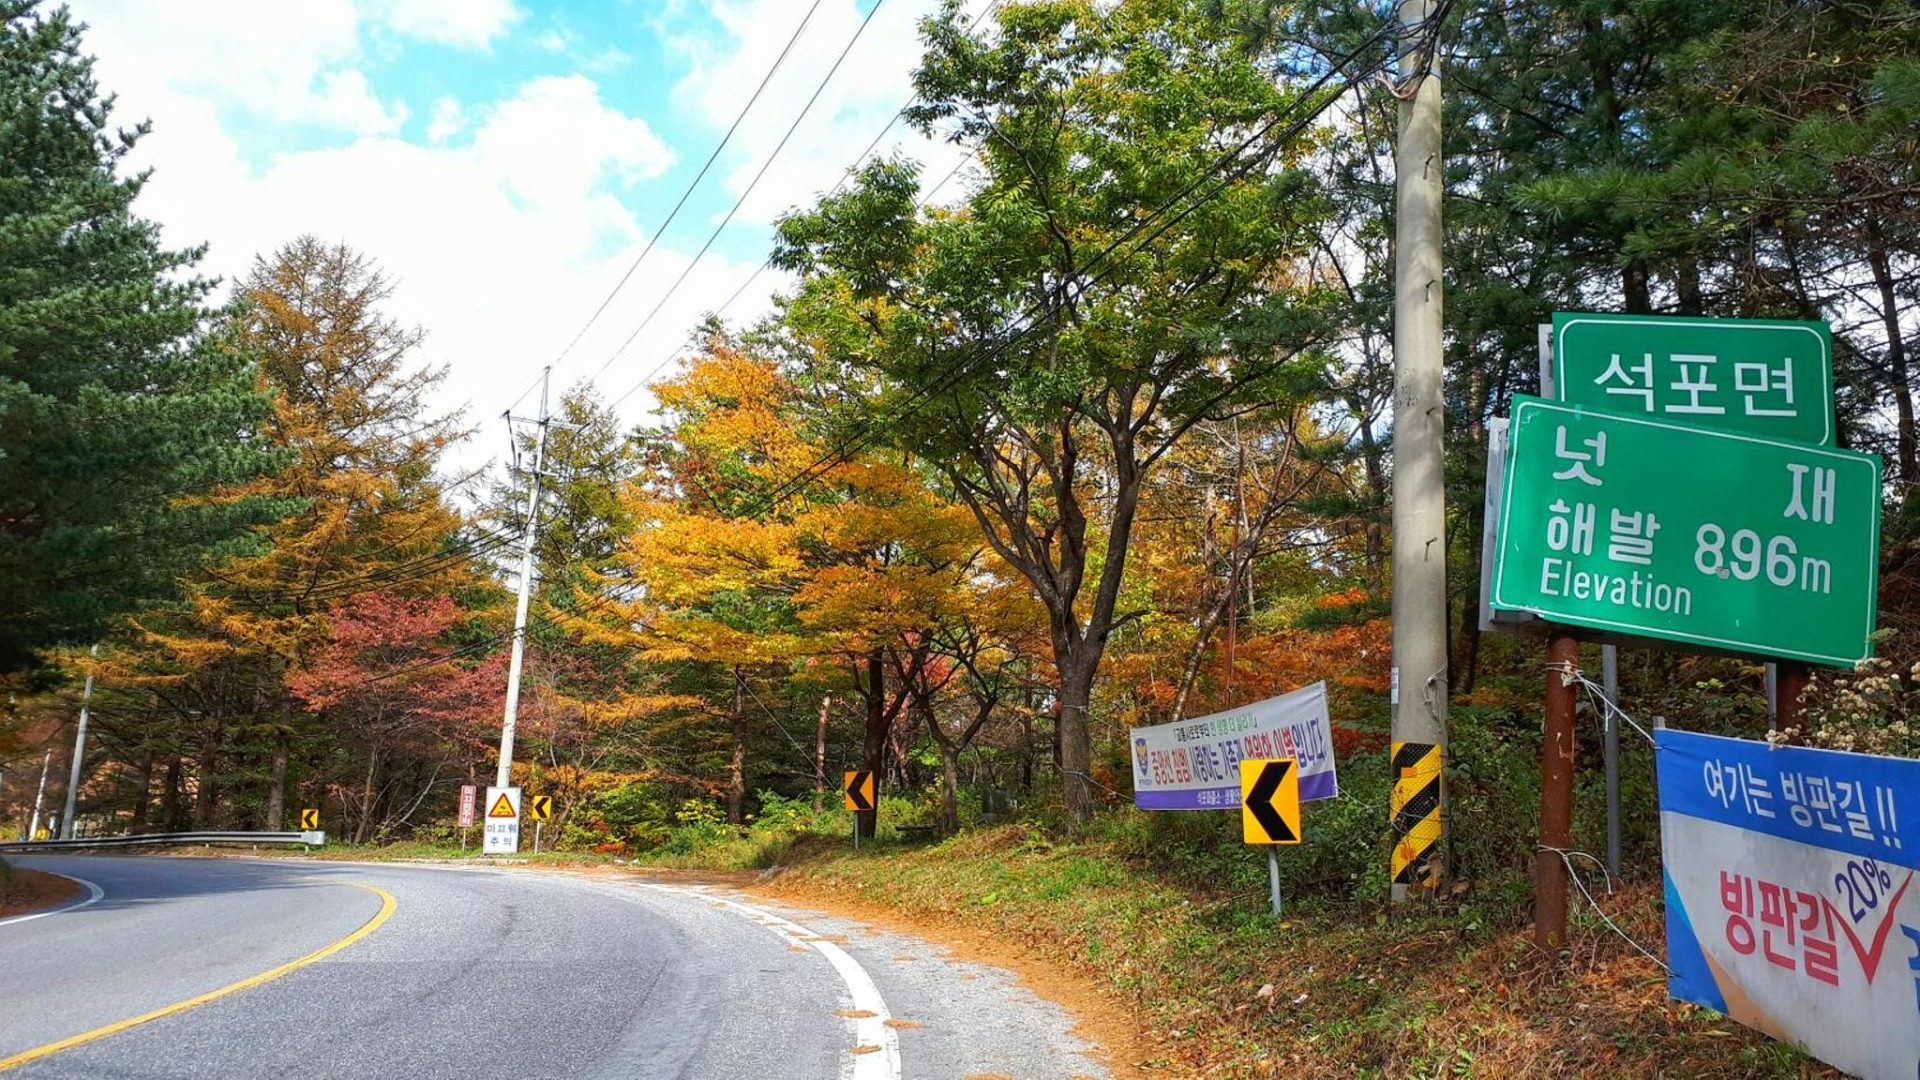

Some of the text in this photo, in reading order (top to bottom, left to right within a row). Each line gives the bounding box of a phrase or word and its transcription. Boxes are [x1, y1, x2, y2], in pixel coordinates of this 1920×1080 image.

[1594, 353, 1797, 417] 석포면
[1552, 425, 1836, 525] 넛 재
[1547, 499, 1831, 594] 해발 896m
[1540, 557, 1691, 616] Elevation
[1151, 750, 1174, 785] 중앙선
[1173, 748, 1192, 784] 침범
[1189, 743, 1223, 783] 사랑하는
[1703, 758, 1777, 819] 여기는
[1834, 853, 1891, 925] 20%
[1720, 870, 1839, 987] 빙판길
